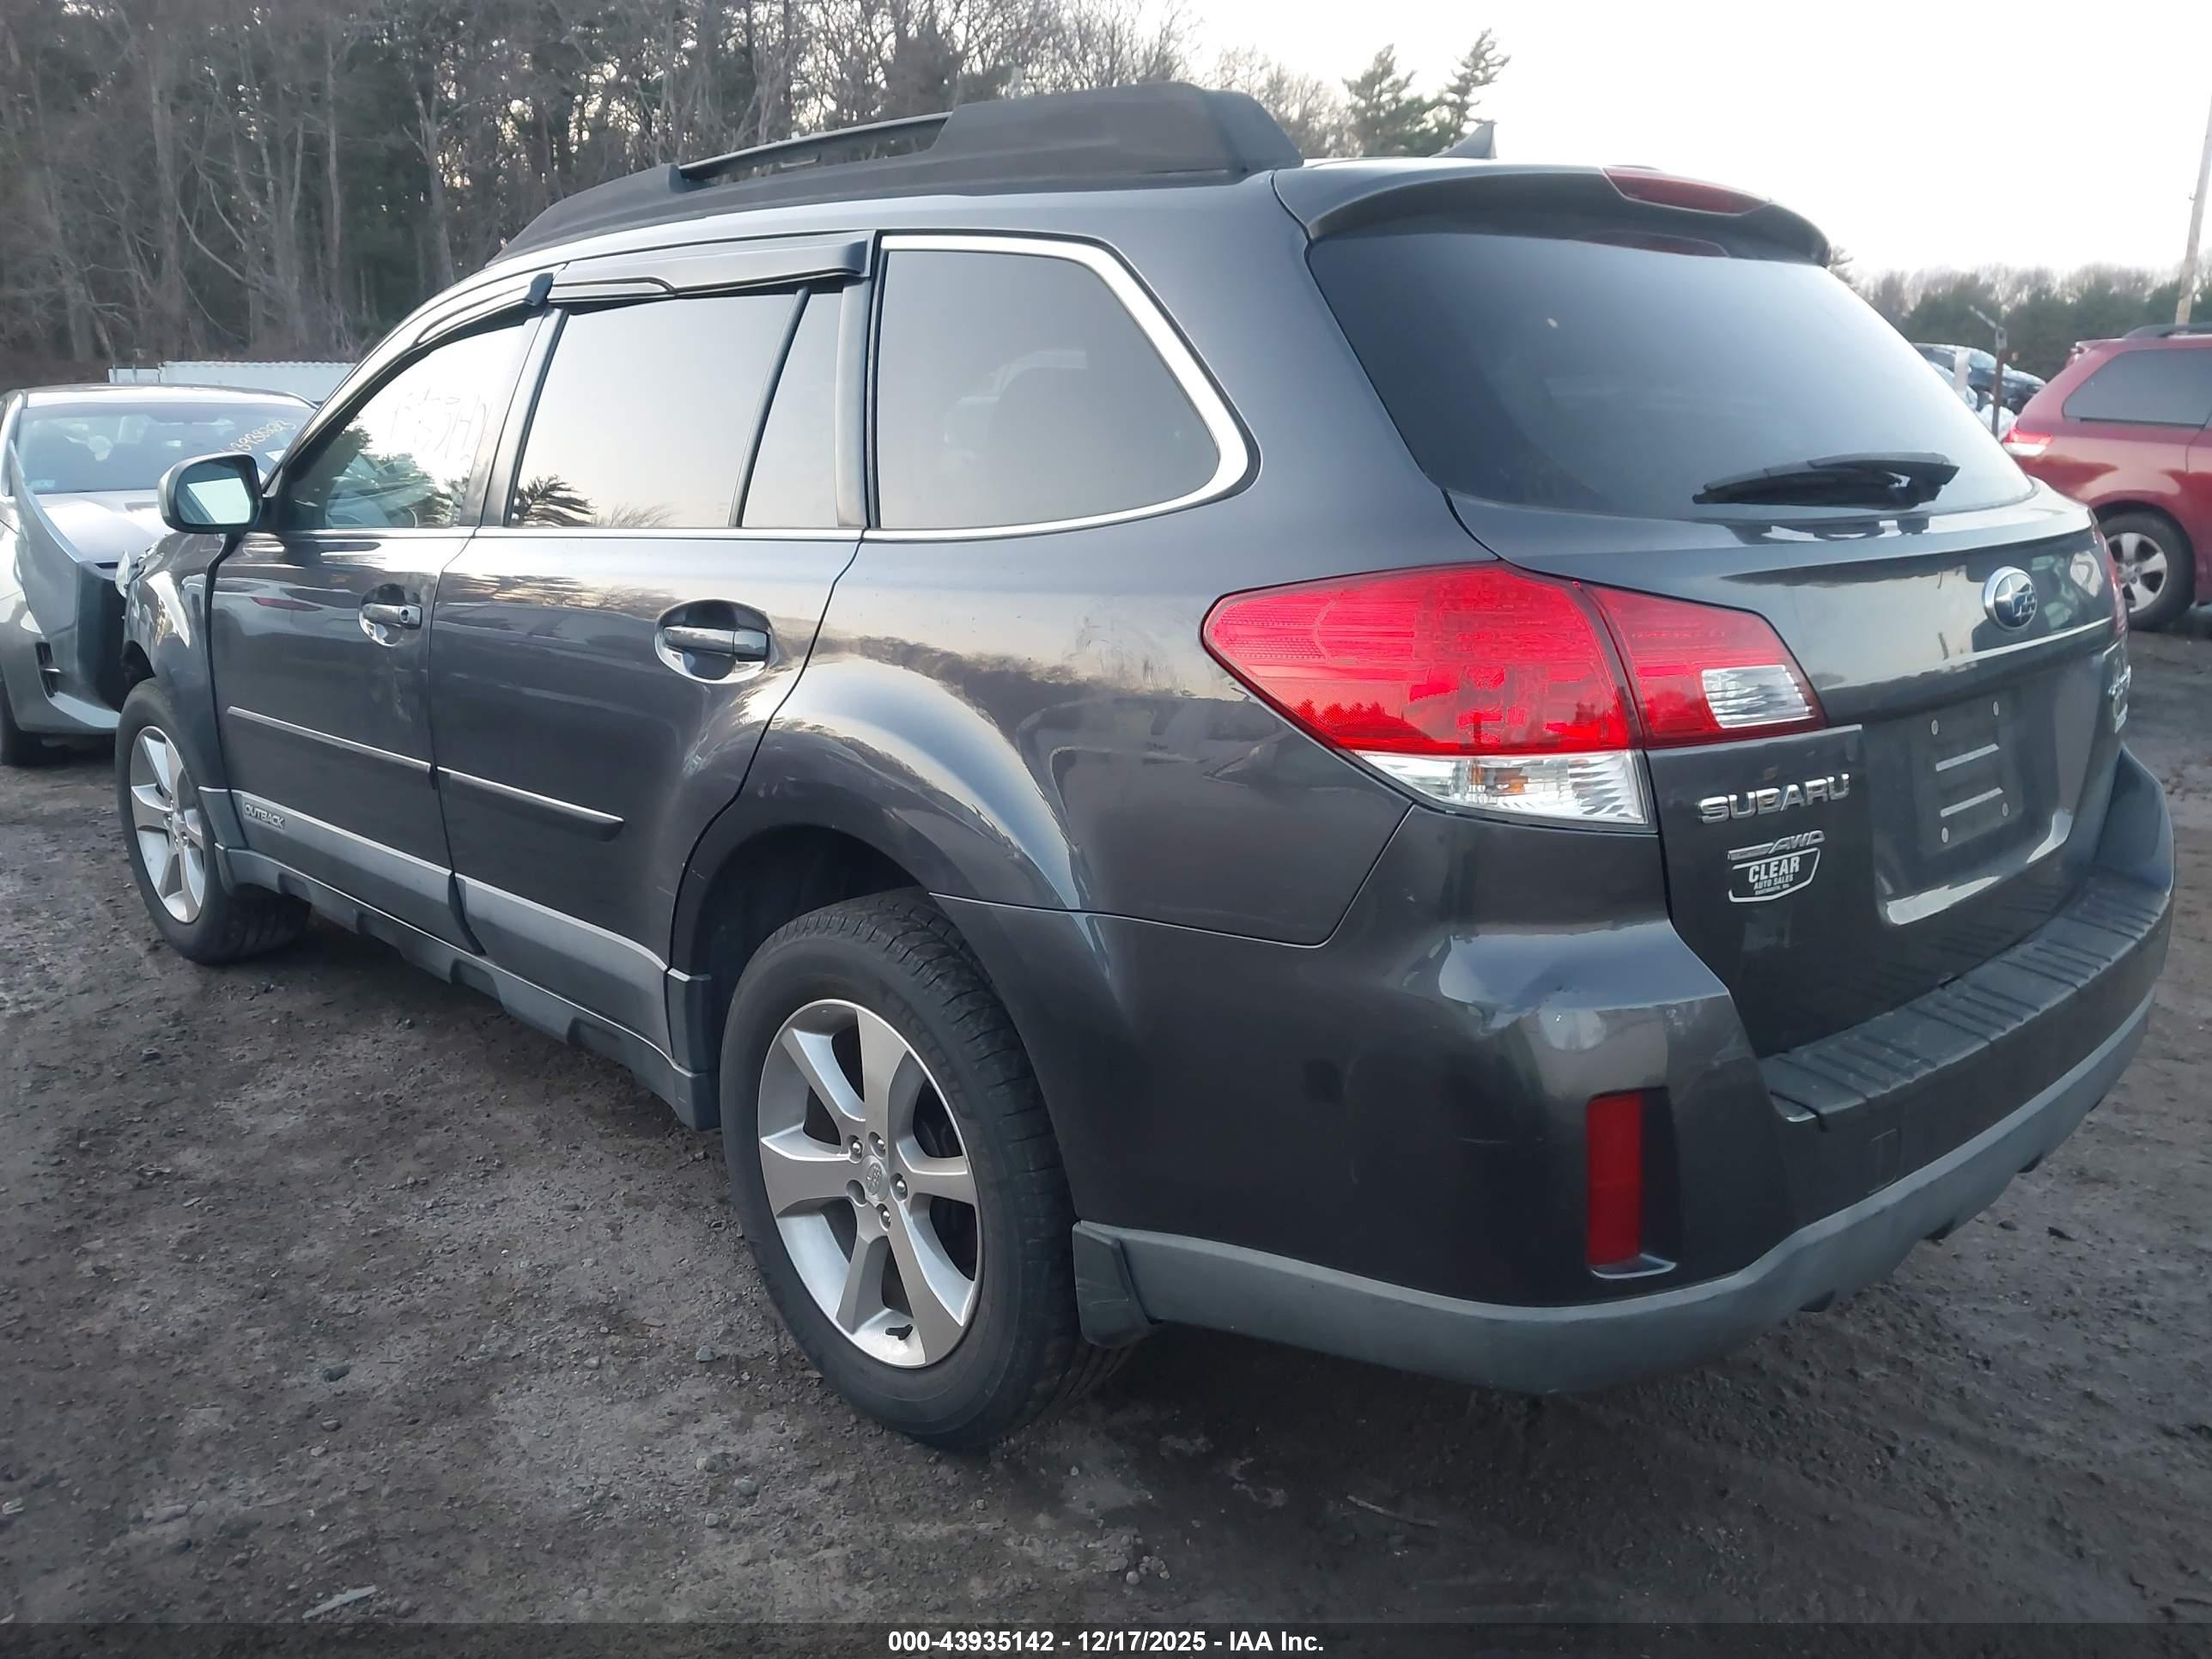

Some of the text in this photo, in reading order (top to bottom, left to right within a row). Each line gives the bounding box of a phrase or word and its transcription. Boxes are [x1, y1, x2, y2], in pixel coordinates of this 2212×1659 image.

[1699, 773, 1850, 823] SUBARU
[245, 804, 284, 829] OUTBACK
[1768, 830, 1826, 854] AWD
[1748, 856, 1801, 884] CLEAR
[1753, 878, 1772, 890] AUTO
[1773, 873, 1794, 886] SALES
